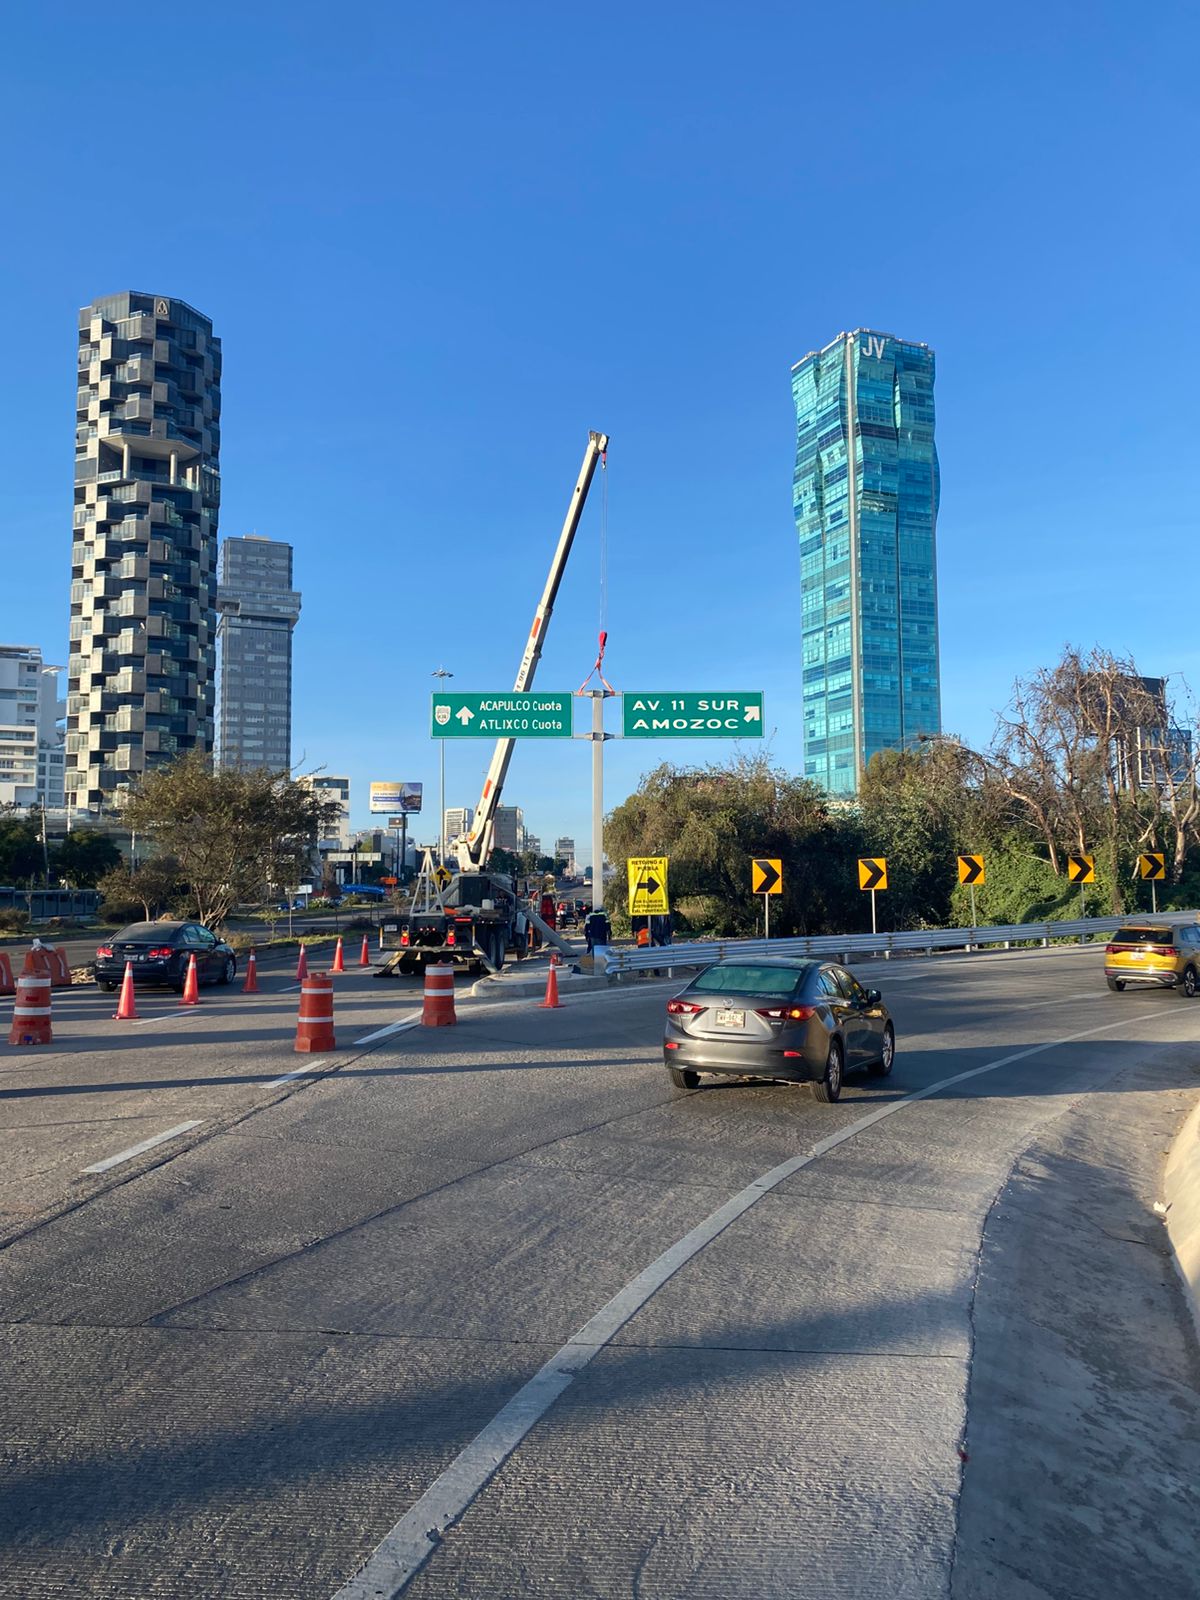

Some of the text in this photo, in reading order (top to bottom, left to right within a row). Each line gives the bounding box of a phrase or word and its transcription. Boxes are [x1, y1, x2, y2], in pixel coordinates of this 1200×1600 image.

[862, 336, 885, 359] JV
[479, 700, 562, 711] ACAPULCO Cuota
[632, 700, 739, 711] AV. 11 SUR
[479, 718, 562, 730] ATLIXCO Cuota
[632, 718, 739, 730] AMOZOC
